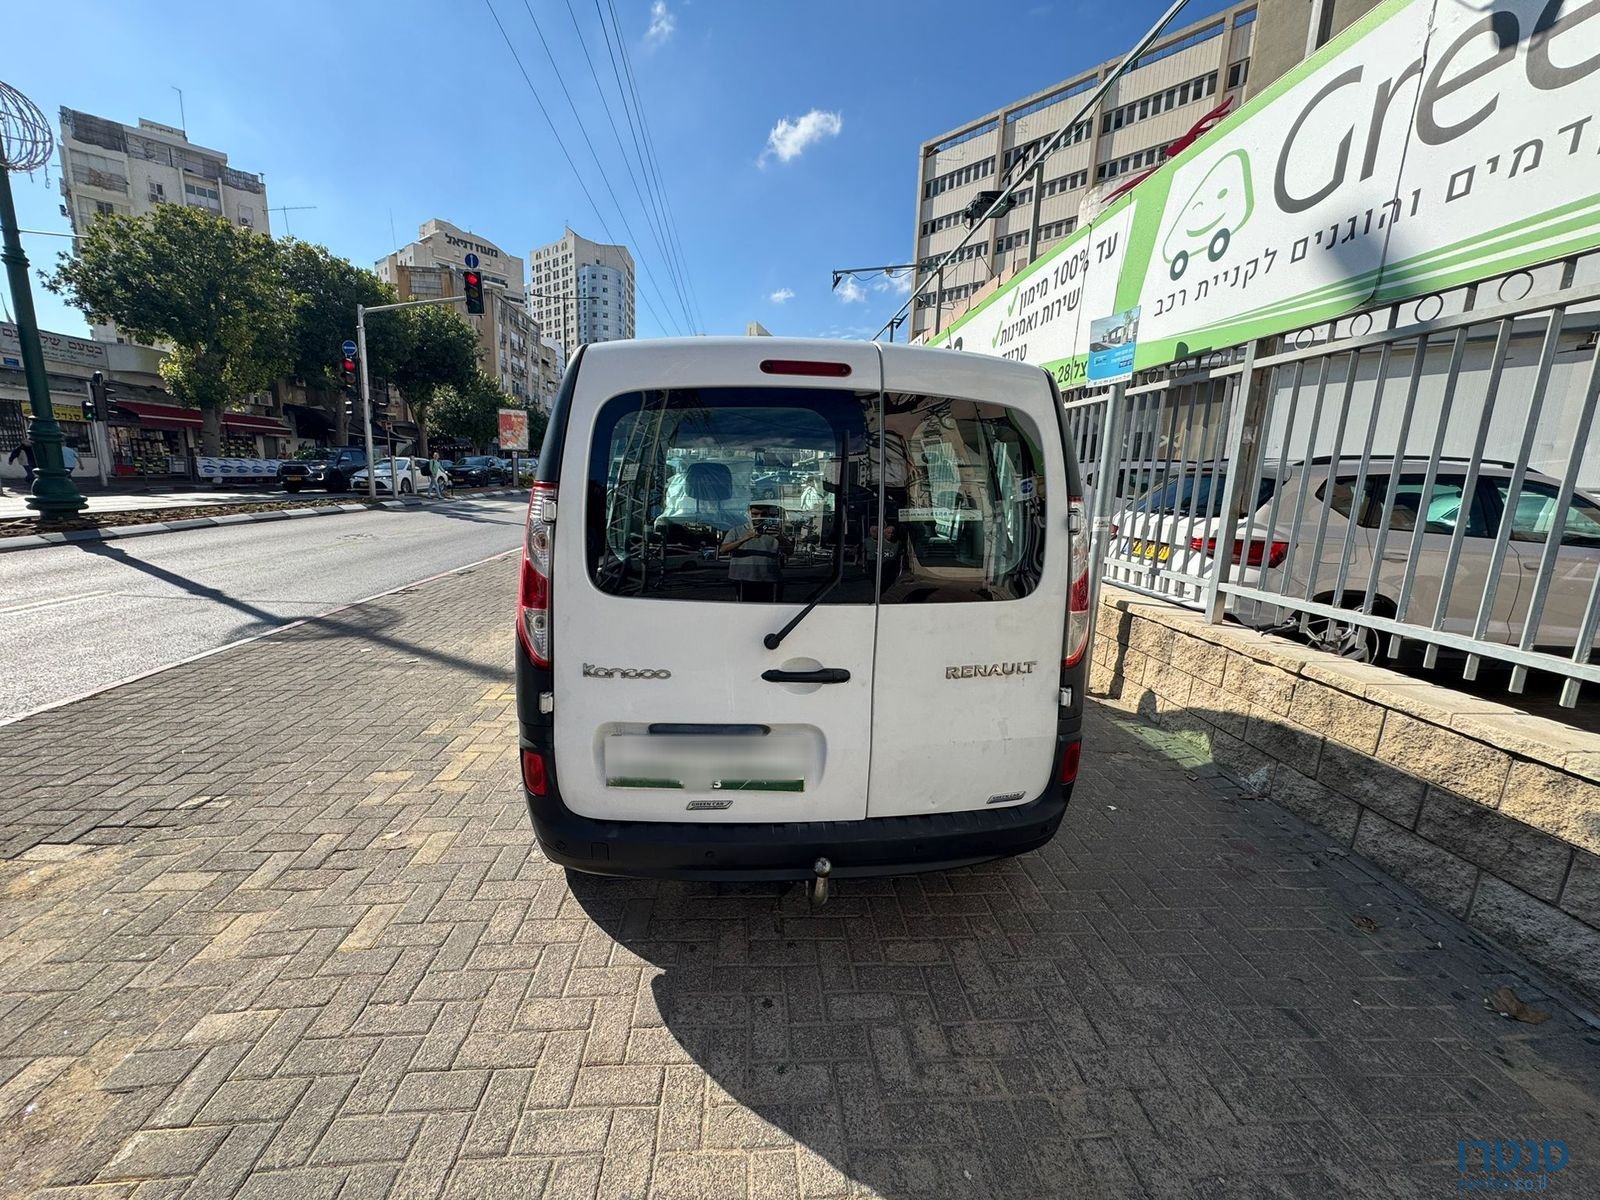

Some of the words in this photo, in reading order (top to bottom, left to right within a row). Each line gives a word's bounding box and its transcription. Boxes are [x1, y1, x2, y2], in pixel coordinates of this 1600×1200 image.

[1445, 115, 1600, 204] דמים
[1289, 187, 1422, 264] והוגנים
[1096, 231, 1119, 264] עד
[1053, 248, 1090, 290] 100%
[1194, 247, 1278, 301] לקניית
[1018, 277, 1049, 317] מימון
[1040, 286, 1081, 326] שירות
[1153, 288, 1187, 317] רכב
[999, 310, 1039, 347] ואמינות
[1057, 363, 1071, 384] 28
[1074, 359, 1088, 380] צל
[945, 660, 1038, 680] RENAULT
